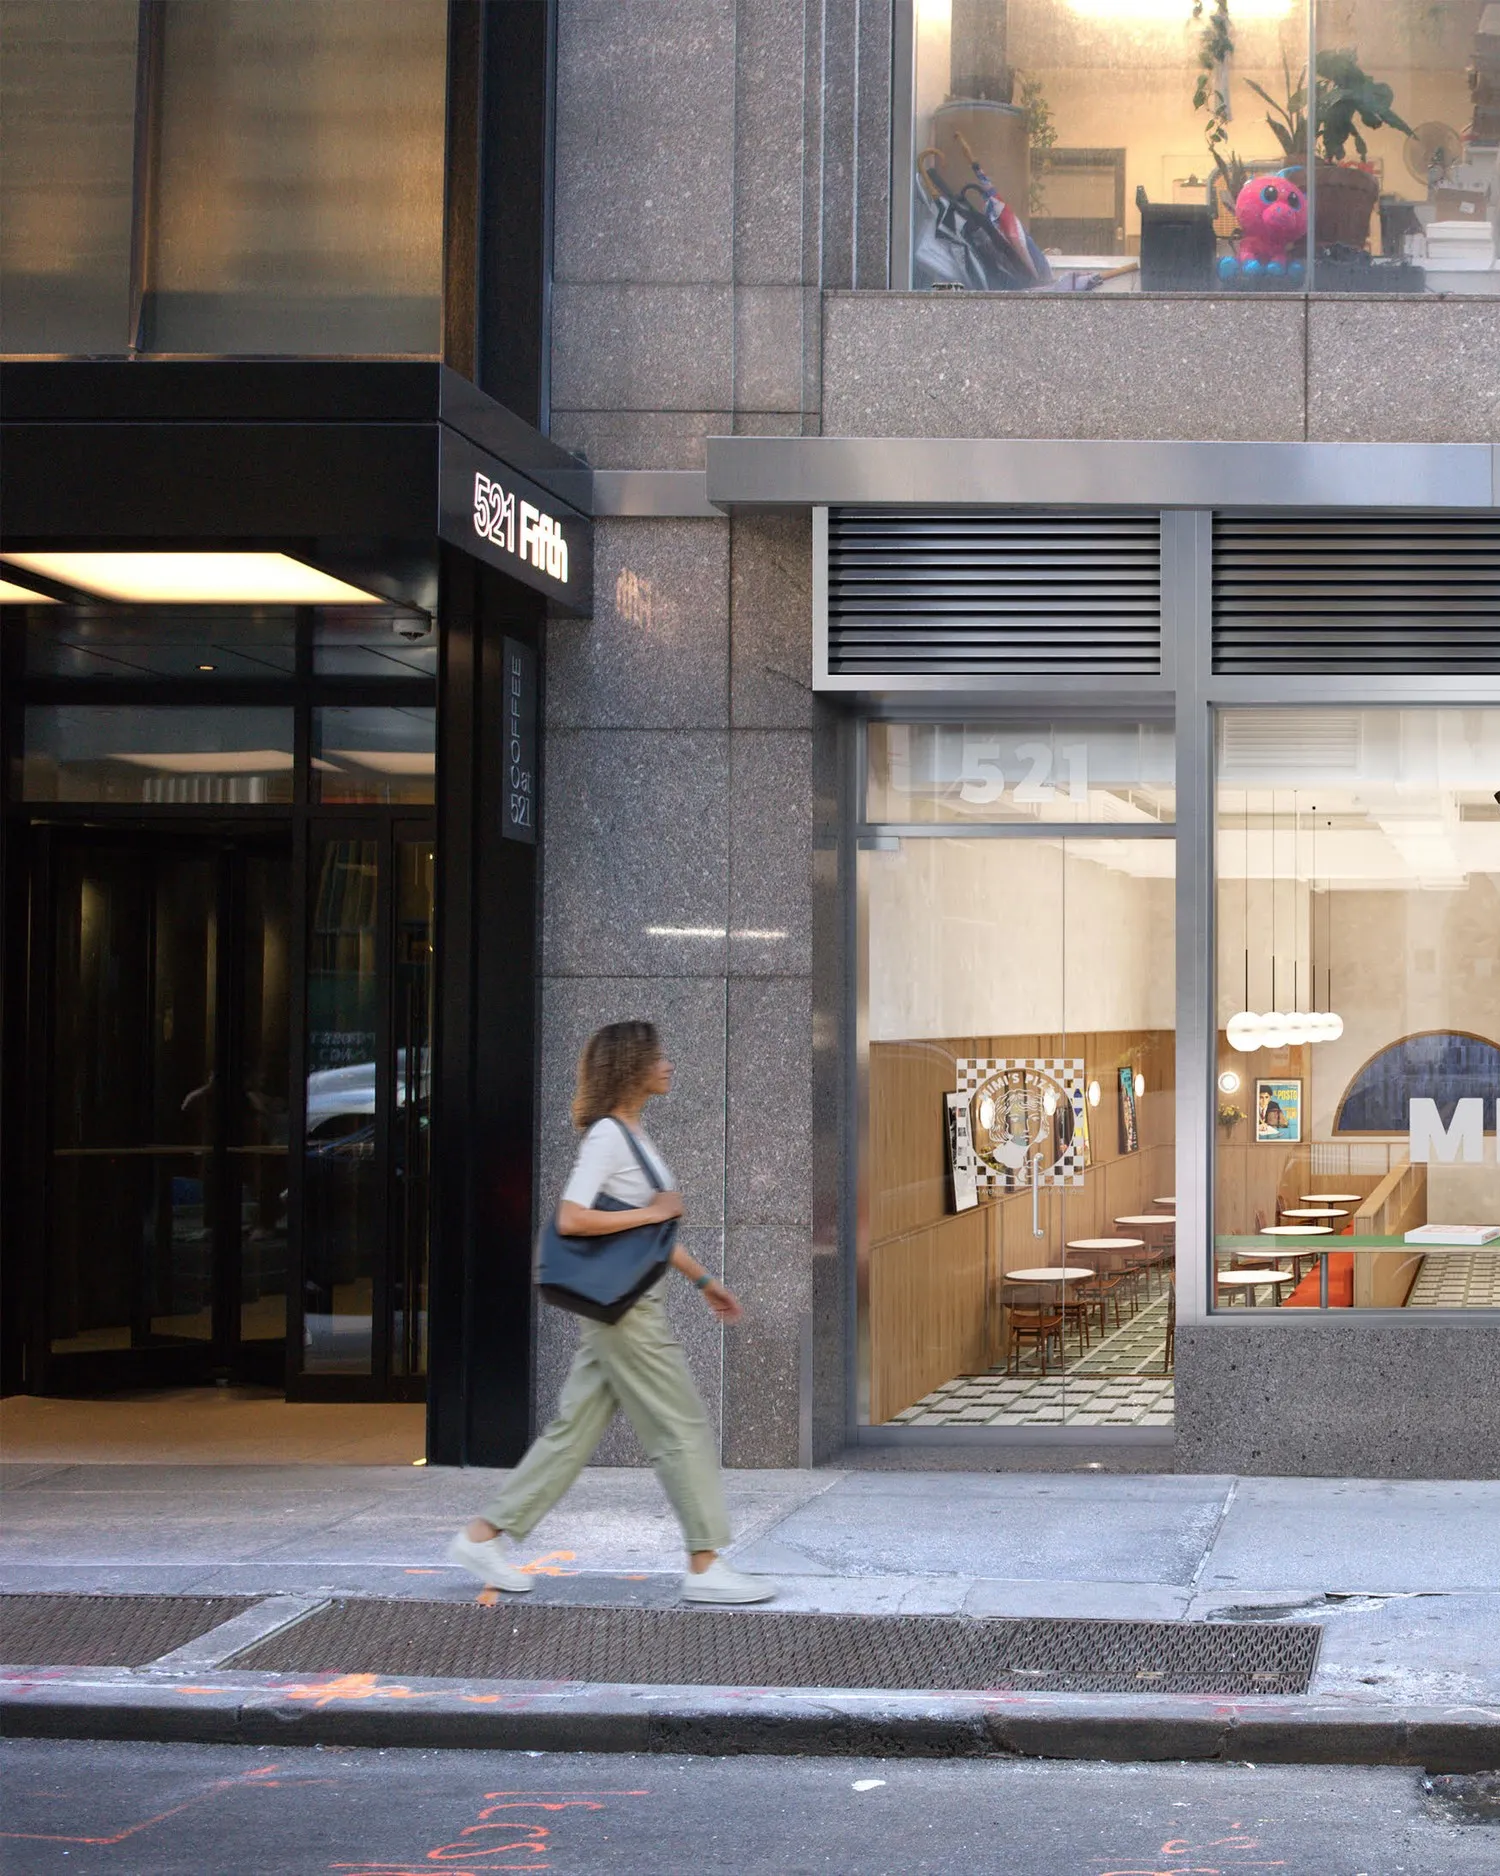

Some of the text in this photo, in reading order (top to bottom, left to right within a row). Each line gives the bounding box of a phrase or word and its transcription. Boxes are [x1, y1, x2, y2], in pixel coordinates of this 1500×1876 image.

[474, 472, 568, 583] 521 Fifth
[510, 656, 521, 788] COFFEE
[521, 772, 531, 793] at
[960, 742, 1088, 803] 521
[510, 794, 531, 826] 521
